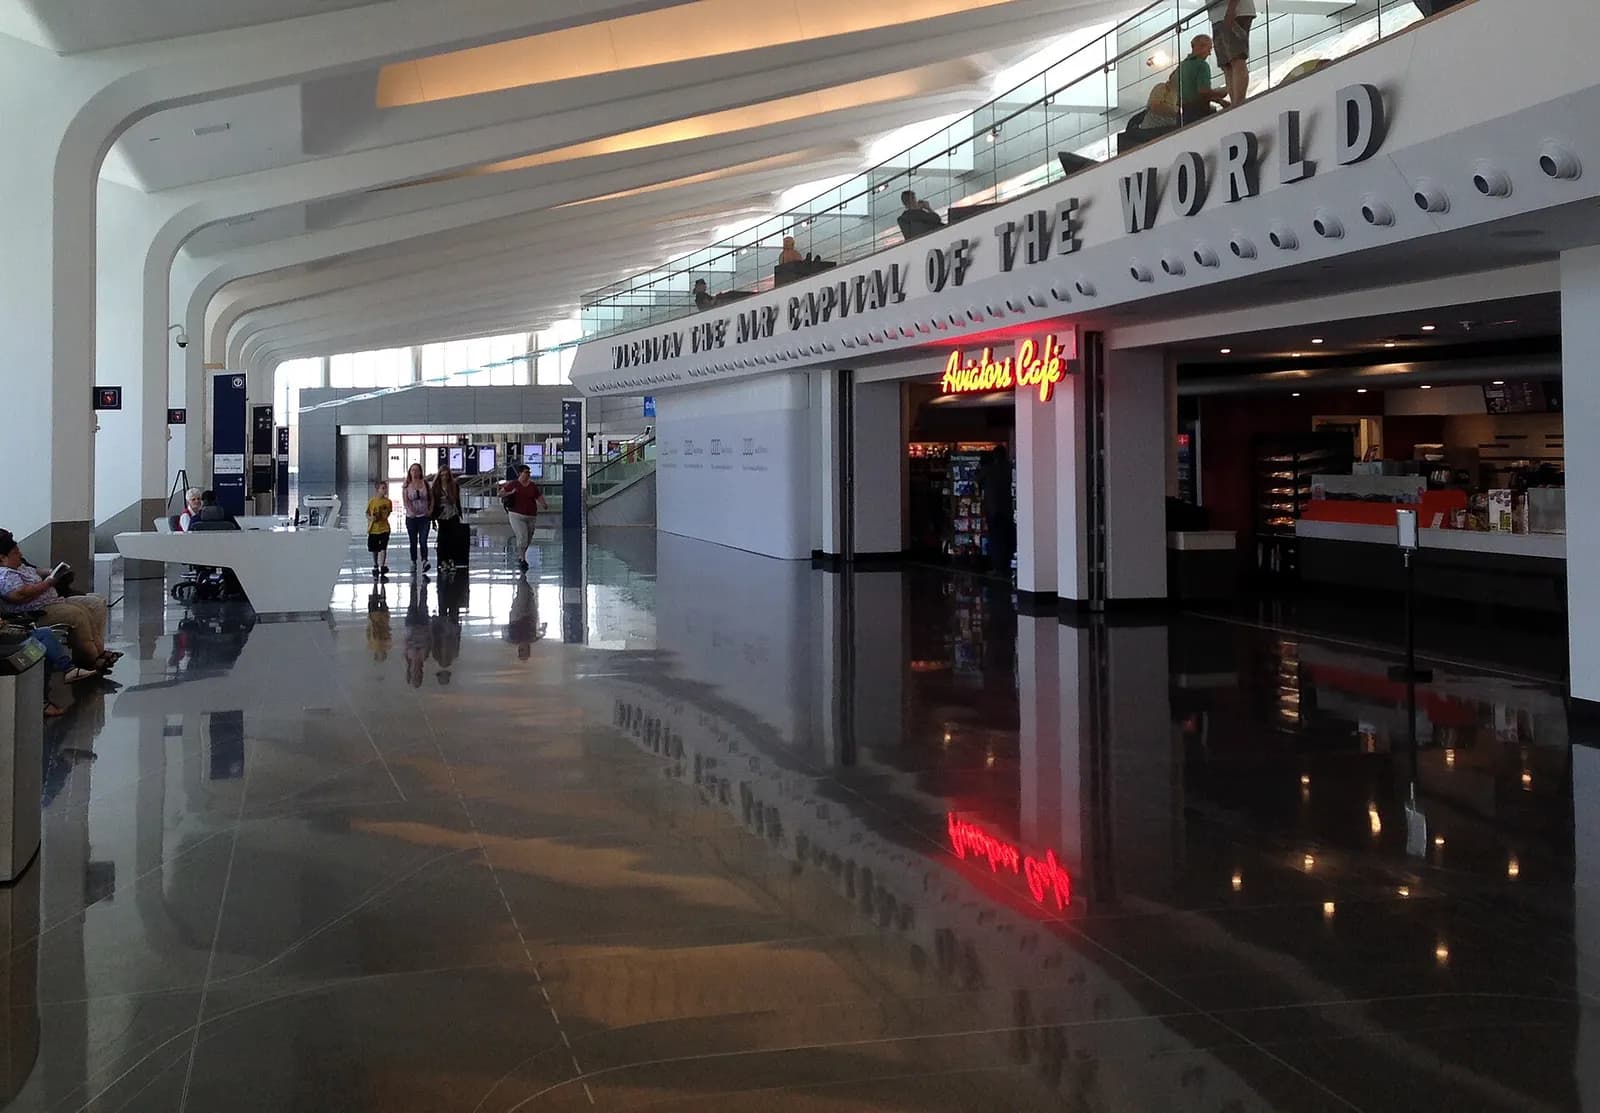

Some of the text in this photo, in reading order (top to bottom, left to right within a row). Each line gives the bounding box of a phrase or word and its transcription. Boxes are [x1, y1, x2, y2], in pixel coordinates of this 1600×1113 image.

[689, 319, 727, 354] THE
[737, 305, 776, 344] AIR
[787, 262, 906, 331] CAPITAL
[925, 238, 970, 293] OF
[994, 197, 1083, 272] THE
[1119, 83, 1387, 234] WORLD
[940, 334, 1066, 402] Aviators Café
[440, 449, 447, 459] 3
[468, 446, 476, 459] 2
[511, 444, 518, 460] 1
